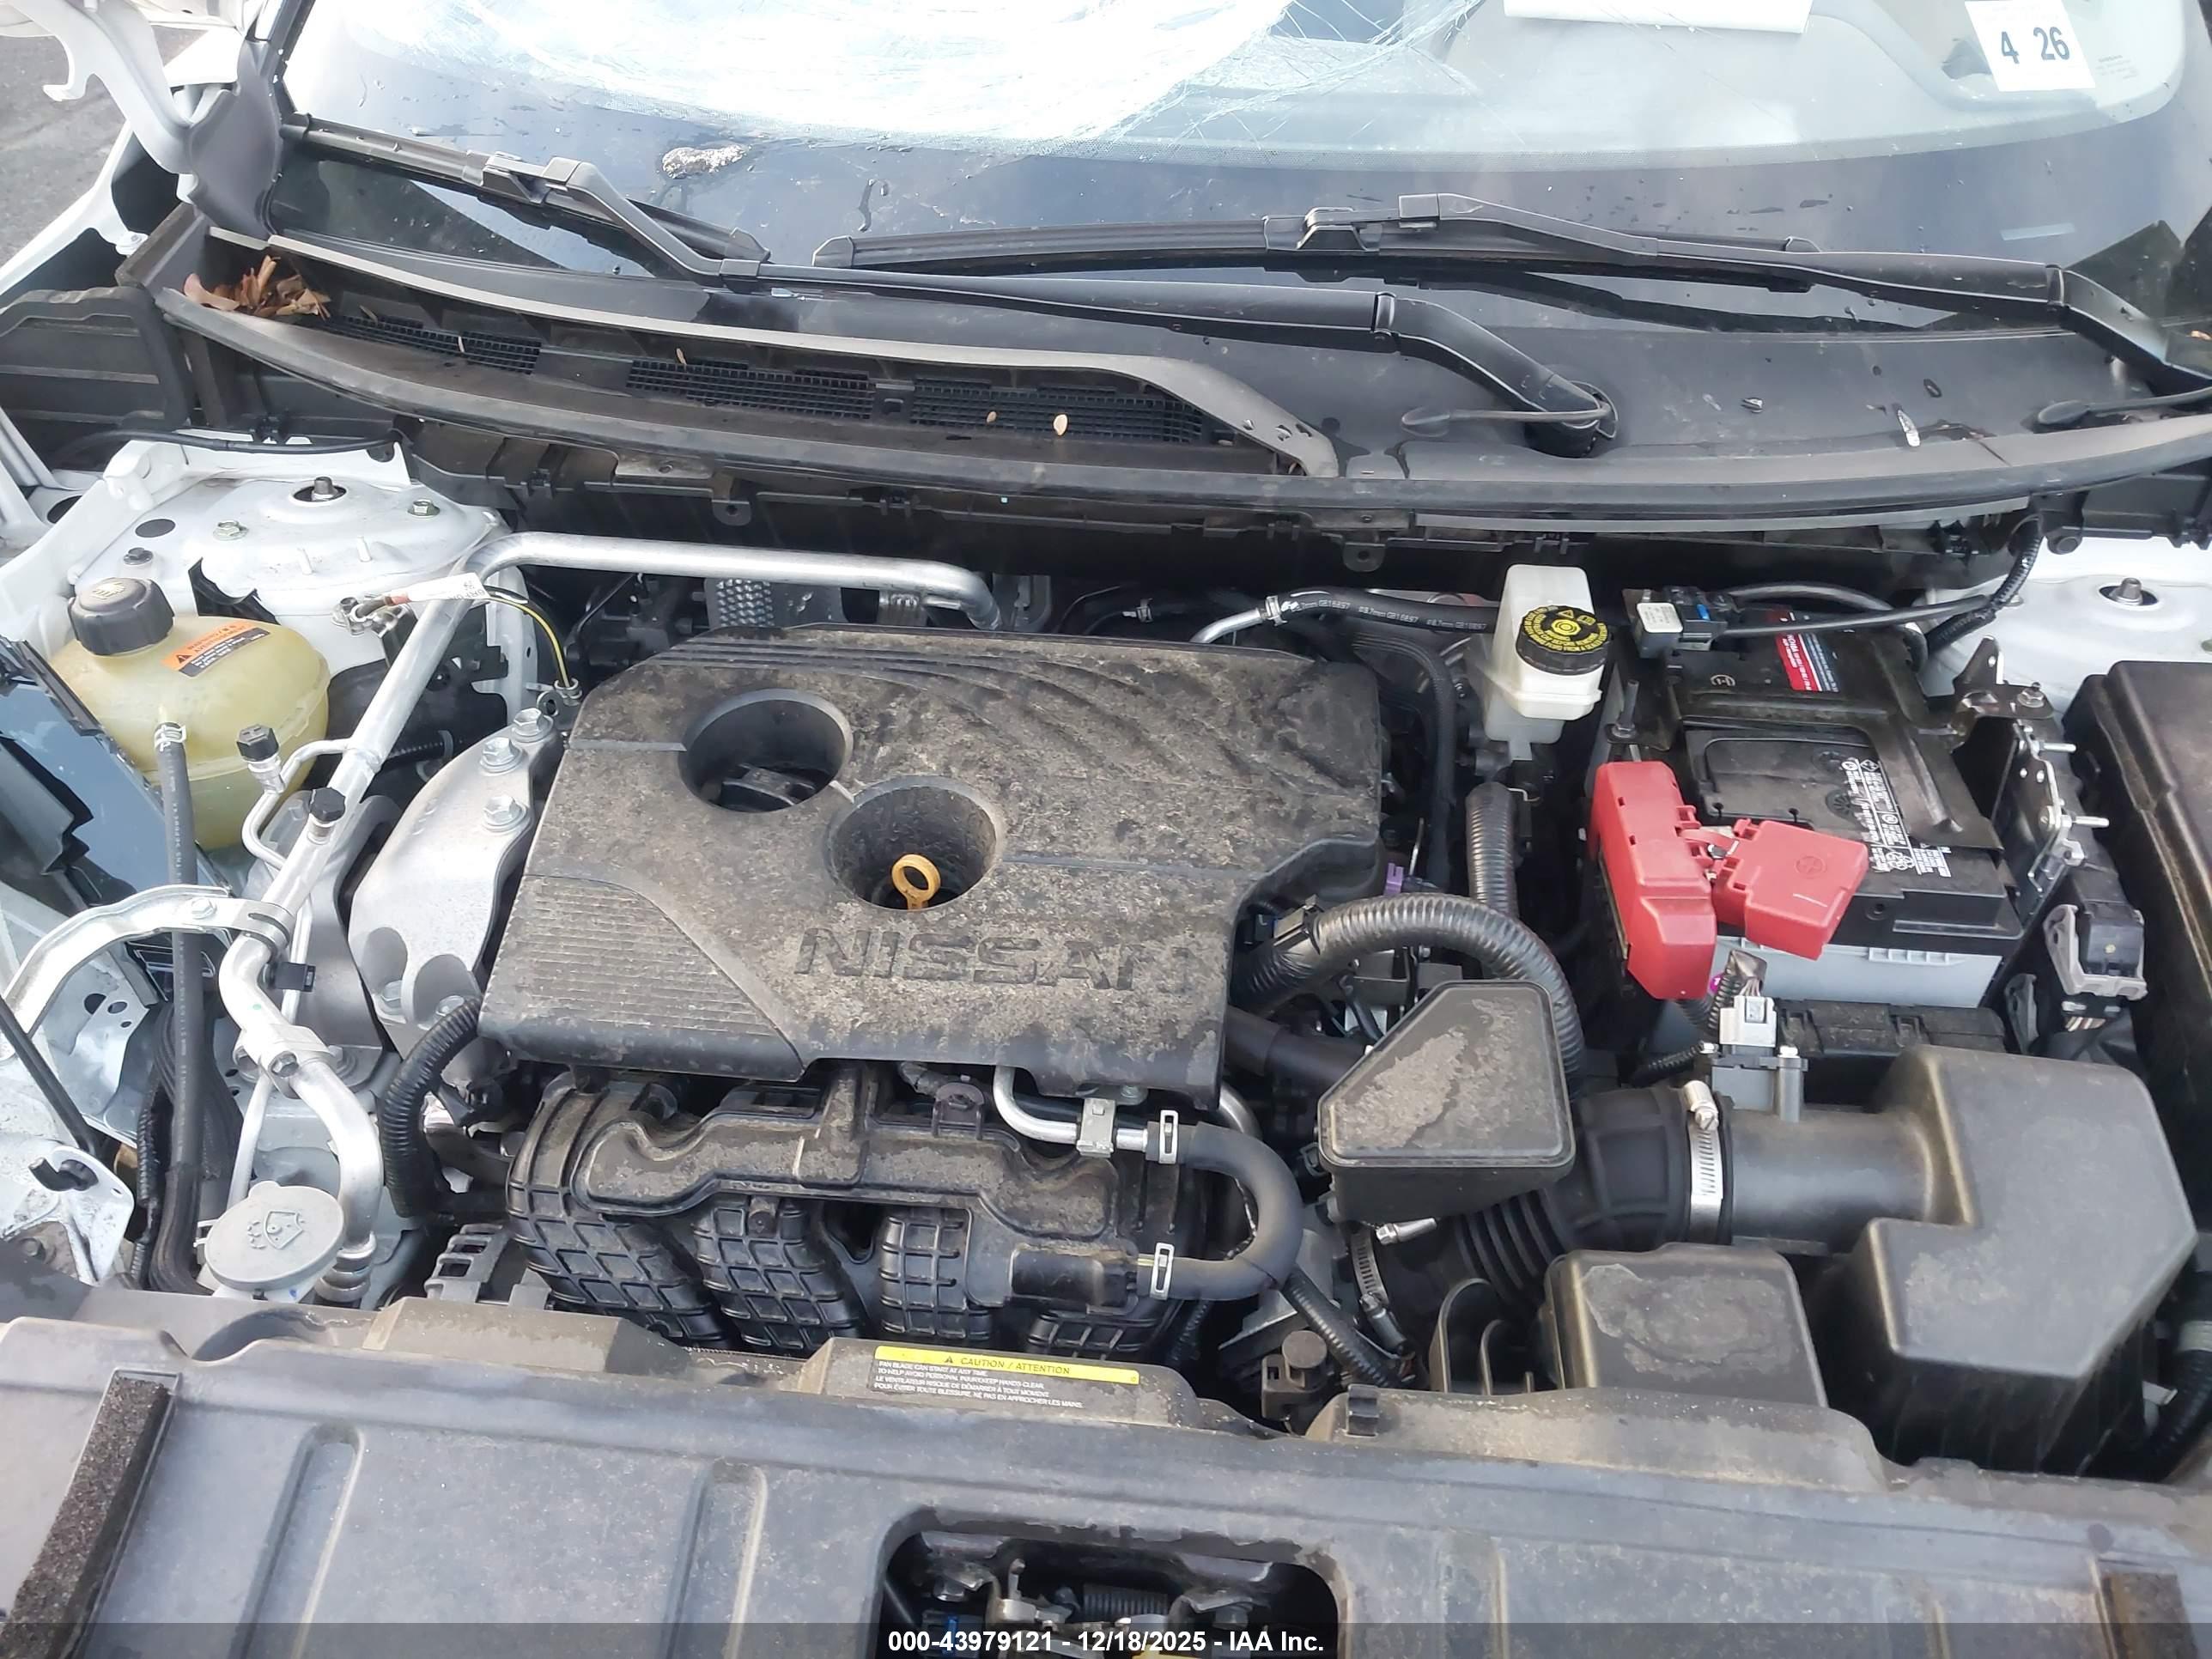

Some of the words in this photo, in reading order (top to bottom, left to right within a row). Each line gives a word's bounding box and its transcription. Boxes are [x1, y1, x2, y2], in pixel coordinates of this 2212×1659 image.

[2001, 31, 2020, 64] 4
[2033, 27, 2070, 60] 26
[960, 1357, 1005, 1368] CAUTION
[1016, 1362, 1070, 1374] ATTENTION
